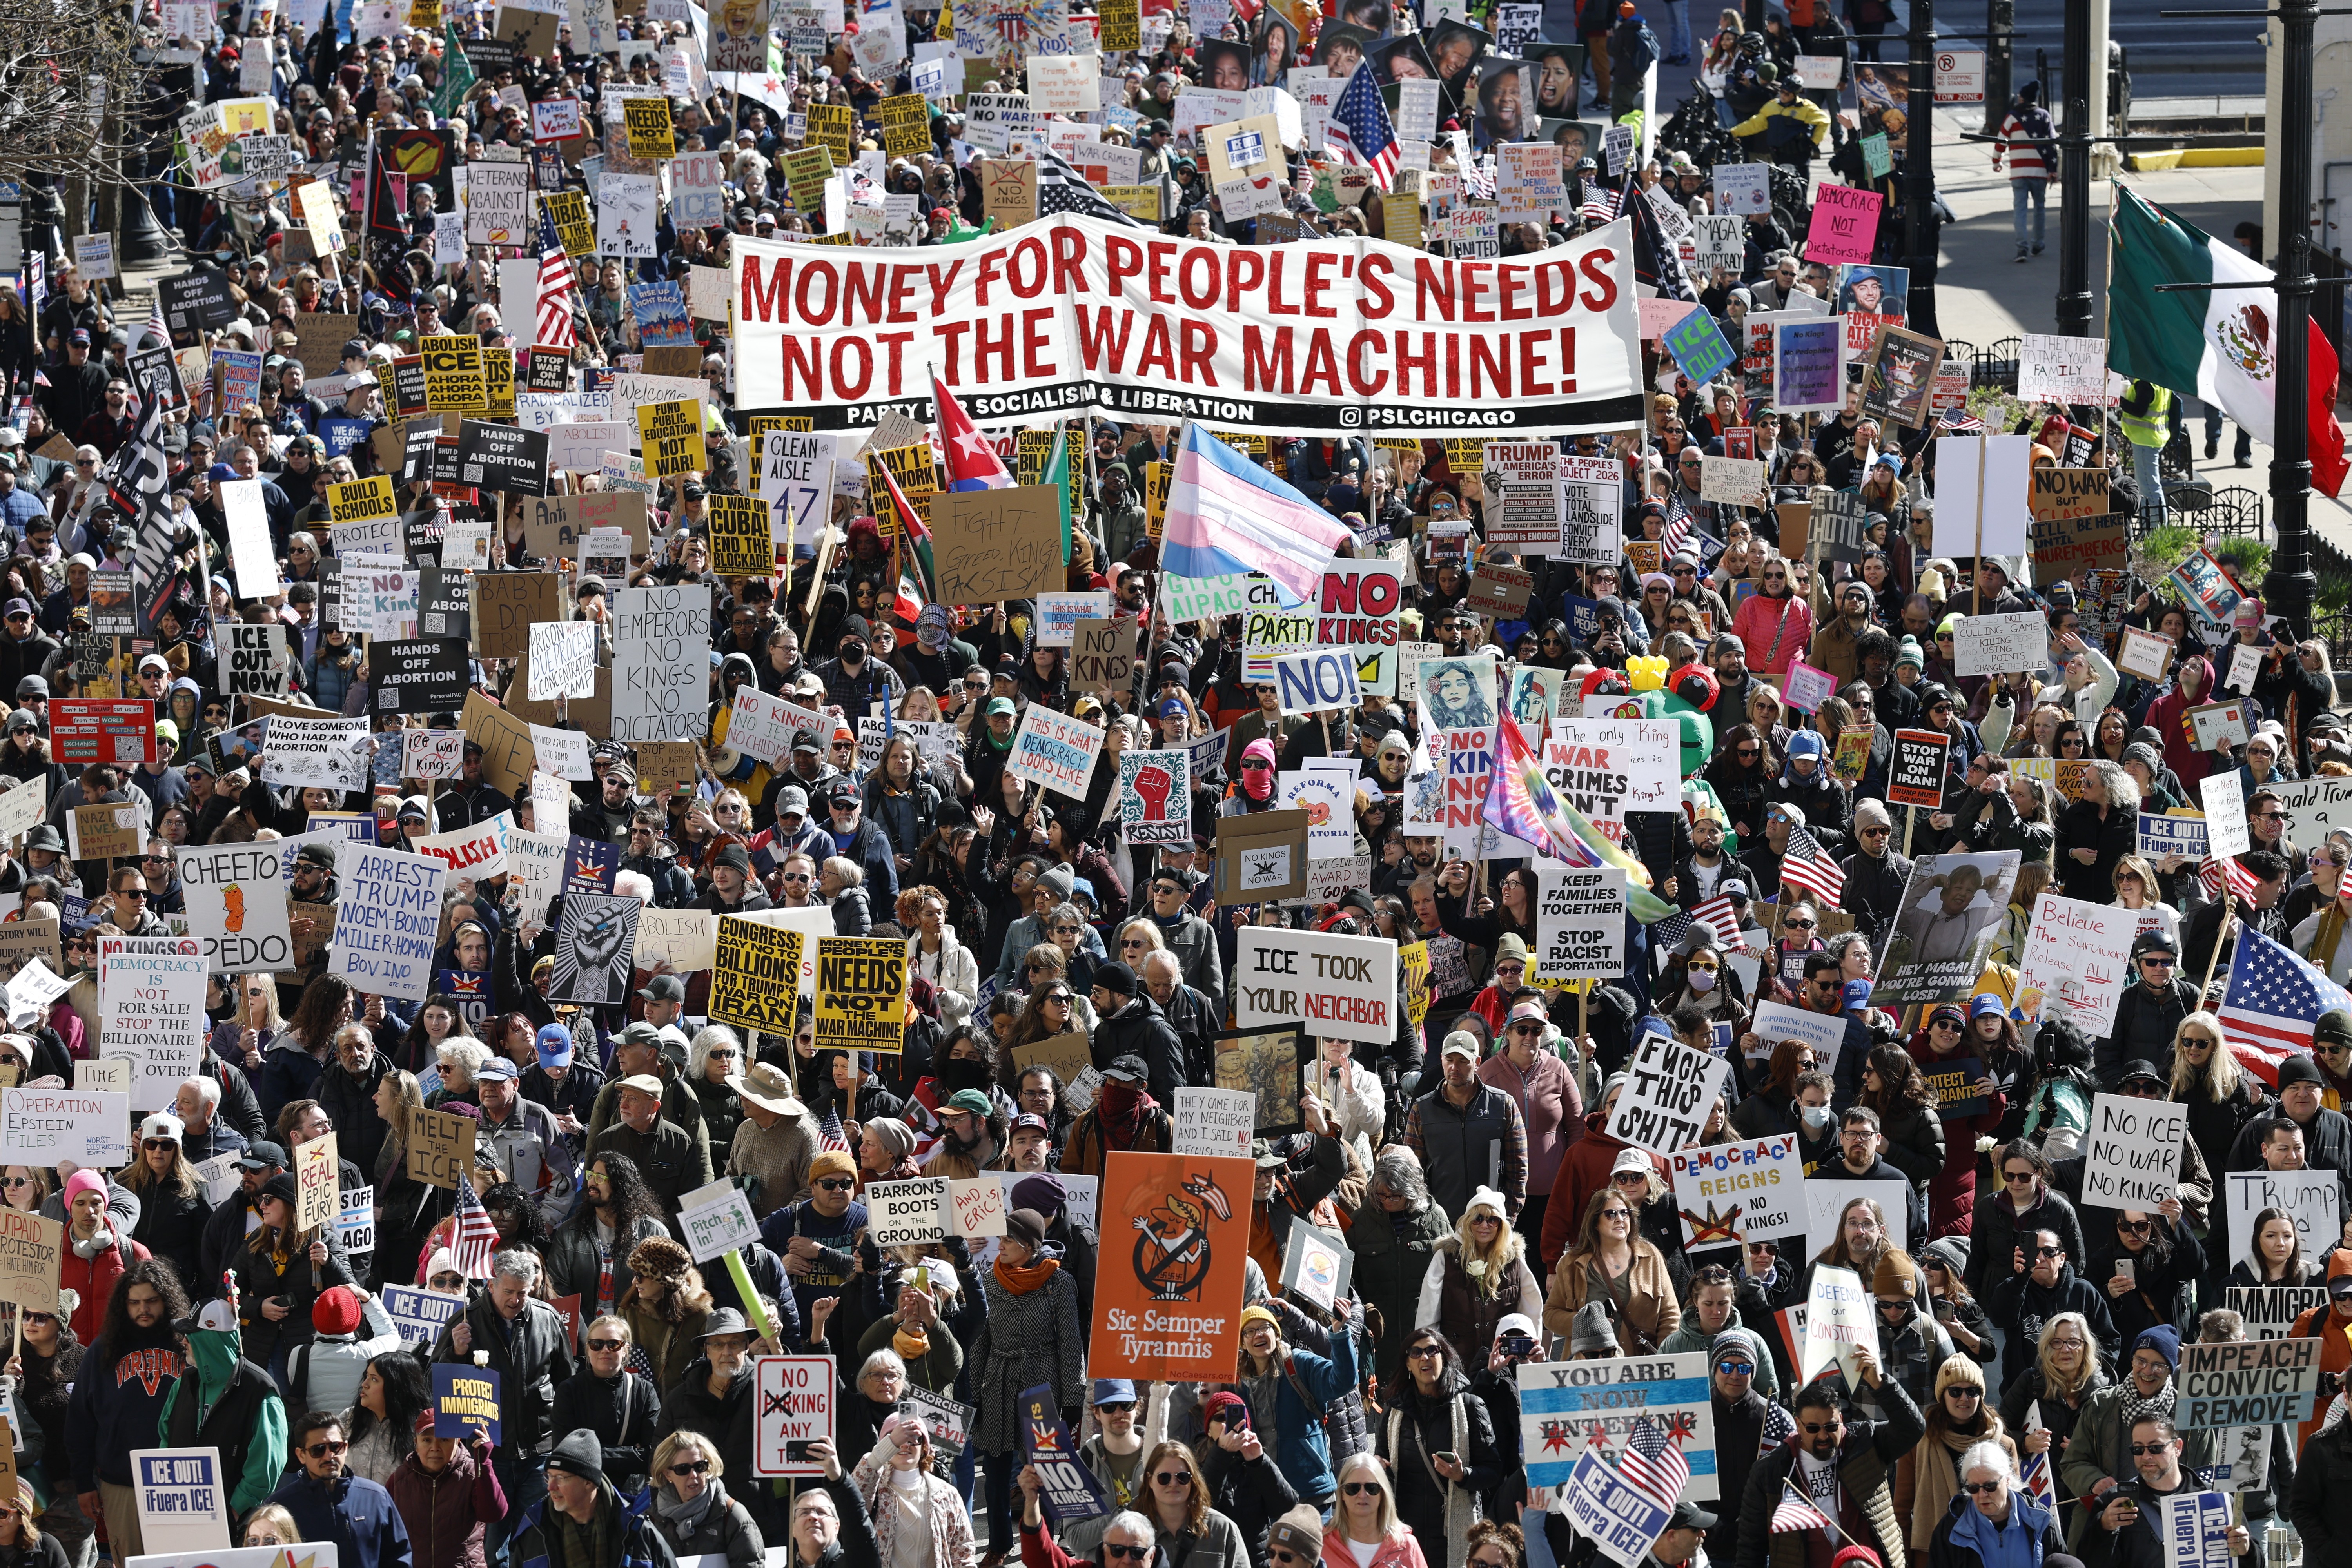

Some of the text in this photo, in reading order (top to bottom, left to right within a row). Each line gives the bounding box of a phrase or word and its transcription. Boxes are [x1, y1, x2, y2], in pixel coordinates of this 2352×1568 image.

[1041, 67, 1066, 76] Trump
[537, 103, 568, 117] Protect
[553, 113, 569, 121] The
[808, 107, 849, 122] MAY 1:
[540, 120, 567, 133] Vote
[808, 122, 849, 135] NO WORK
[468, 169, 527, 185] VETERANS
[998, 187, 1022, 195] NO
[470, 191, 522, 209] AGAINST
[995, 196, 1027, 204] KINGS
[1817, 187, 1881, 212] DEMOCRACY
[469, 211, 525, 229] FASCISM
[1453, 211, 1497, 227] FEAR the
[1832, 216, 1857, 232] NOT
[1452, 226, 1496, 238] PEOPLE
[79, 253, 110, 262] CHICAGO
[1807, 240, 1872, 260] Dictatorship!
[173, 276, 209, 289] HANDS
[740, 226, 1618, 329] MONEY FOR PEOPLE'S NEEDS
[183, 287, 203, 298] OFF
[639, 287, 670, 298] RISE UP
[172, 294, 223, 312] ABORTION
[635, 296, 679, 309] FIGHT BACK
[1673, 314, 1714, 354] ICE
[421, 338, 477, 353] ABOLISH
[781, 304, 1577, 402] NOT THE WAR MACHINE!
[424, 350, 476, 372] ICE
[534, 355, 564, 364] STOP
[1686, 338, 1726, 379] OUT
[1902, 347, 1930, 361] KINGS
[537, 364, 561, 372] WAR
[532, 379, 563, 388] IRAN!
[656, 404, 681, 413] FUND
[976, 382, 1097, 414] SOCIALISM
[1100, 386, 1115, 404] &
[1122, 388, 1254, 421] LIBERATION
[652, 413, 686, 426] PUBLIC
[1367, 408, 1515, 425] PSLCHICAGO
[646, 422, 697, 440] EDUCATION
[659, 439, 686, 456] NOT
[1488, 445, 1554, 461] TRUMP
[656, 454, 695, 476] WAR!
[1502, 461, 1556, 471] AMERICA'S
[511, 476, 538, 486] PersonalPAC
[1518, 471, 1553, 481] ERROR
[1528, 532, 1559, 540] ENOUGH!
[646, 589, 681, 611] NO
[1322, 572, 1400, 617] NO
[619, 609, 709, 641] EMPERORS
[1318, 617, 1397, 646] KINGS
[232, 627, 268, 649] ICE
[2144, 642, 2159, 654] KINGS
[232, 649, 271, 671] OUT
[2130, 652, 2157, 666] SINCE 1776
[230, 671, 282, 693] NOW
[1900, 732, 1944, 743] RefuseFascism.org
[1901, 743, 1940, 755] STOP
[1903, 753, 1936, 766] WAR
[1907, 765, 1928, 775] ON
[1897, 773, 1937, 787] IRAN!
[1893, 787, 1916, 796] TRUMP
[110, 959, 203, 972] DEMOCRACY
[1254, 948, 1373, 983] ICE TOOK
[148, 974, 162, 985] IS
[134, 988, 169, 1000] NOT
[118, 1002, 191, 1015] FOR SALE!
[1242, 985, 1387, 1027] YOUR NEIGHBOR
[7, 1090, 102, 1114] OPERATION
[8, 1113, 74, 1130] EPSTEIN
[2104, 1106, 2180, 1143] NO ICE
[7, 1131, 56, 1147] FILES
[2094, 1140, 2174, 1178] NO WAR
[871, 1180, 944, 1198] BARRON'S
[1700, 1169, 1780, 1196] REIGNS
[888, 1198, 939, 1215] BOOTS
[1750, 1197, 1767, 1209] NO
[1745, 1210, 1788, 1230] KINGS!
[877, 1227, 944, 1243] GROUND
[1107, 1307, 1225, 1340] Sic Semper
[1120, 1332, 1212, 1363] Tyrannis
[2188, 1341, 2313, 1373] IMPEACH
[1169, 1370, 1233, 1381] NoCaesars.org
[2187, 1367, 2307, 1397] CONVICT
[452, 1379, 492, 1398] PROTECT
[441, 1397, 499, 1421] IMMIGRANTS
[913, 1387, 965, 1415] EXORCISE
[2190, 1395, 2301, 1427] REMOVE
[1033, 1452, 1070, 1461] CHICAGO SAYS
[151, 1459, 203, 1483] ICE OUT!
[1034, 1463, 1083, 1490] NO
[1049, 1490, 1094, 1505] KINGS
